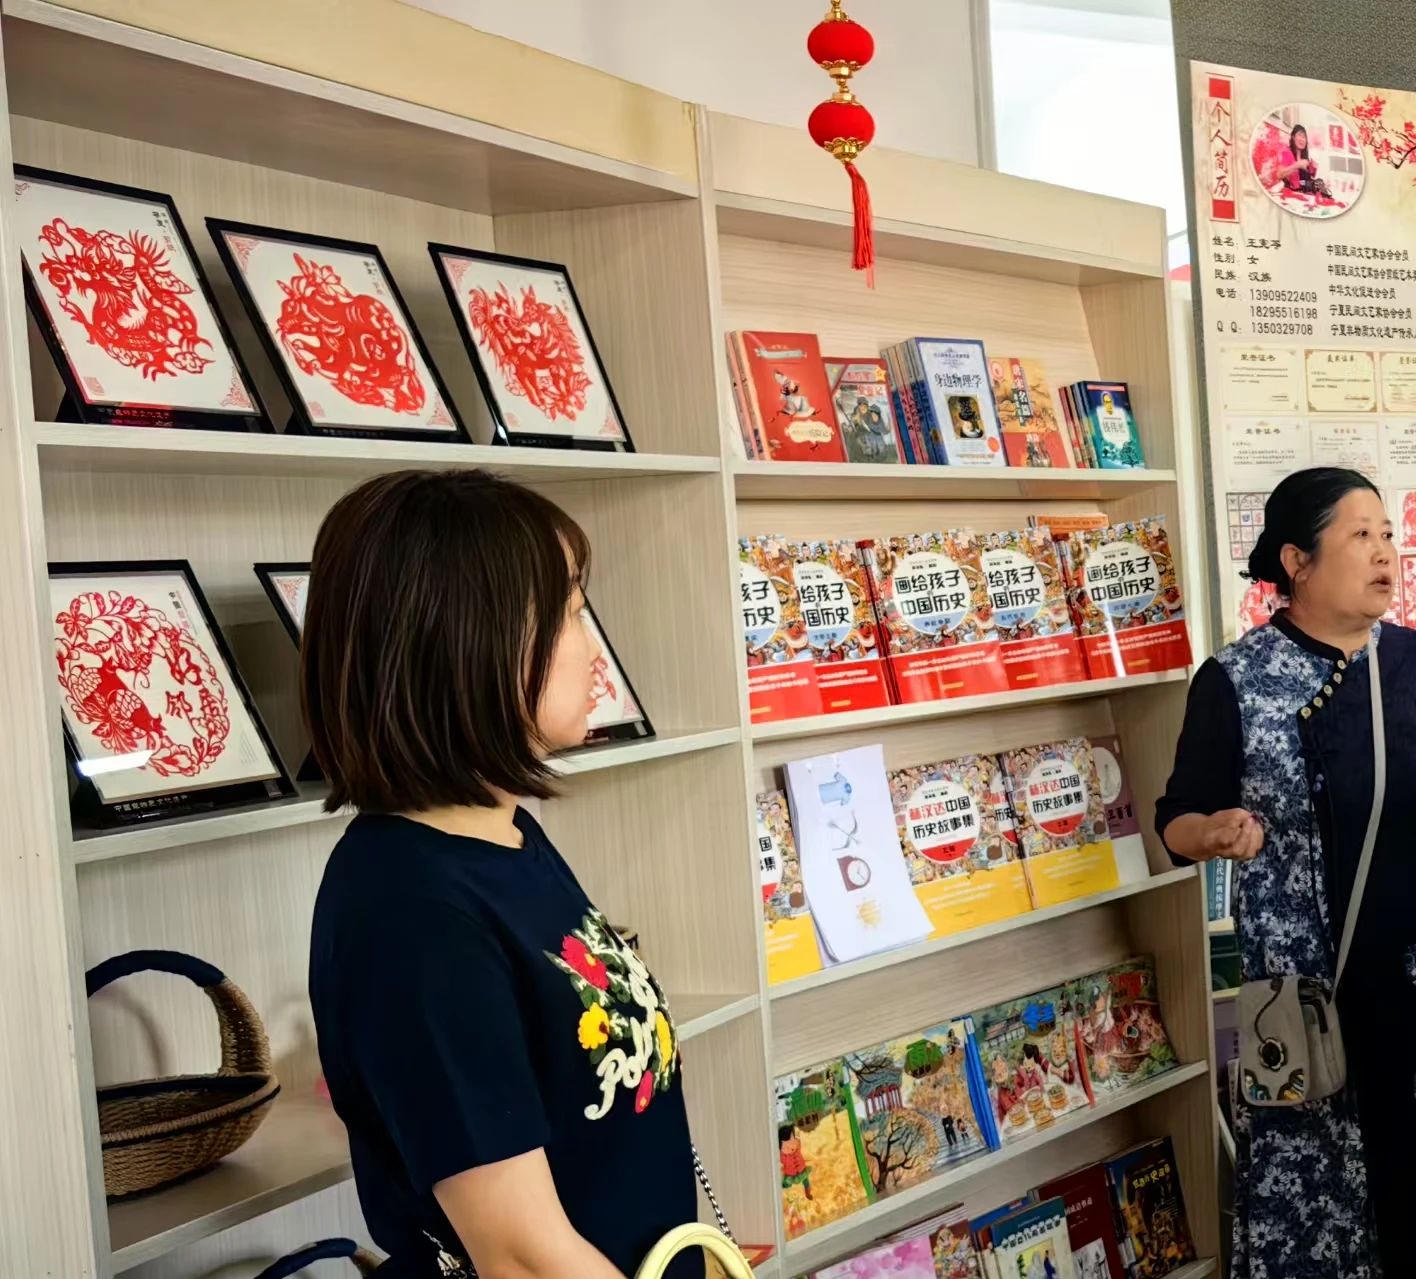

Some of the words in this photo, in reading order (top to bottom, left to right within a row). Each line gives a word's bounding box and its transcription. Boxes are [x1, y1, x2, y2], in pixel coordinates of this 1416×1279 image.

[1209, 101, 1233, 198] 个人简历
[1247, 255, 1260, 265] 女
[1248, 272, 1272, 282] 汉族
[1250, 289, 1317, 303] 13909522409
[1250, 306, 1318, 319] 18295516198
[1251, 323, 1313, 336] 1350329708
[934, 372, 982, 388] 身边物理学
[895, 567, 961, 594] 画给孩子
[983, 567, 1036, 594] 给孩子
[1086, 556, 1151, 583] 画给孩子
[795, 581, 846, 603] 给孩子
[988, 586, 1041, 609] 国历史
[1090, 577, 1156, 601] 中国历史
[901, 592, 967, 616] 中国历史
[801, 606, 850, 627] 国历史
[1032, 791, 1084, 815] 历史故事集
[913, 813, 976, 839] 历史故事集
[759, 857, 777, 873] 集
